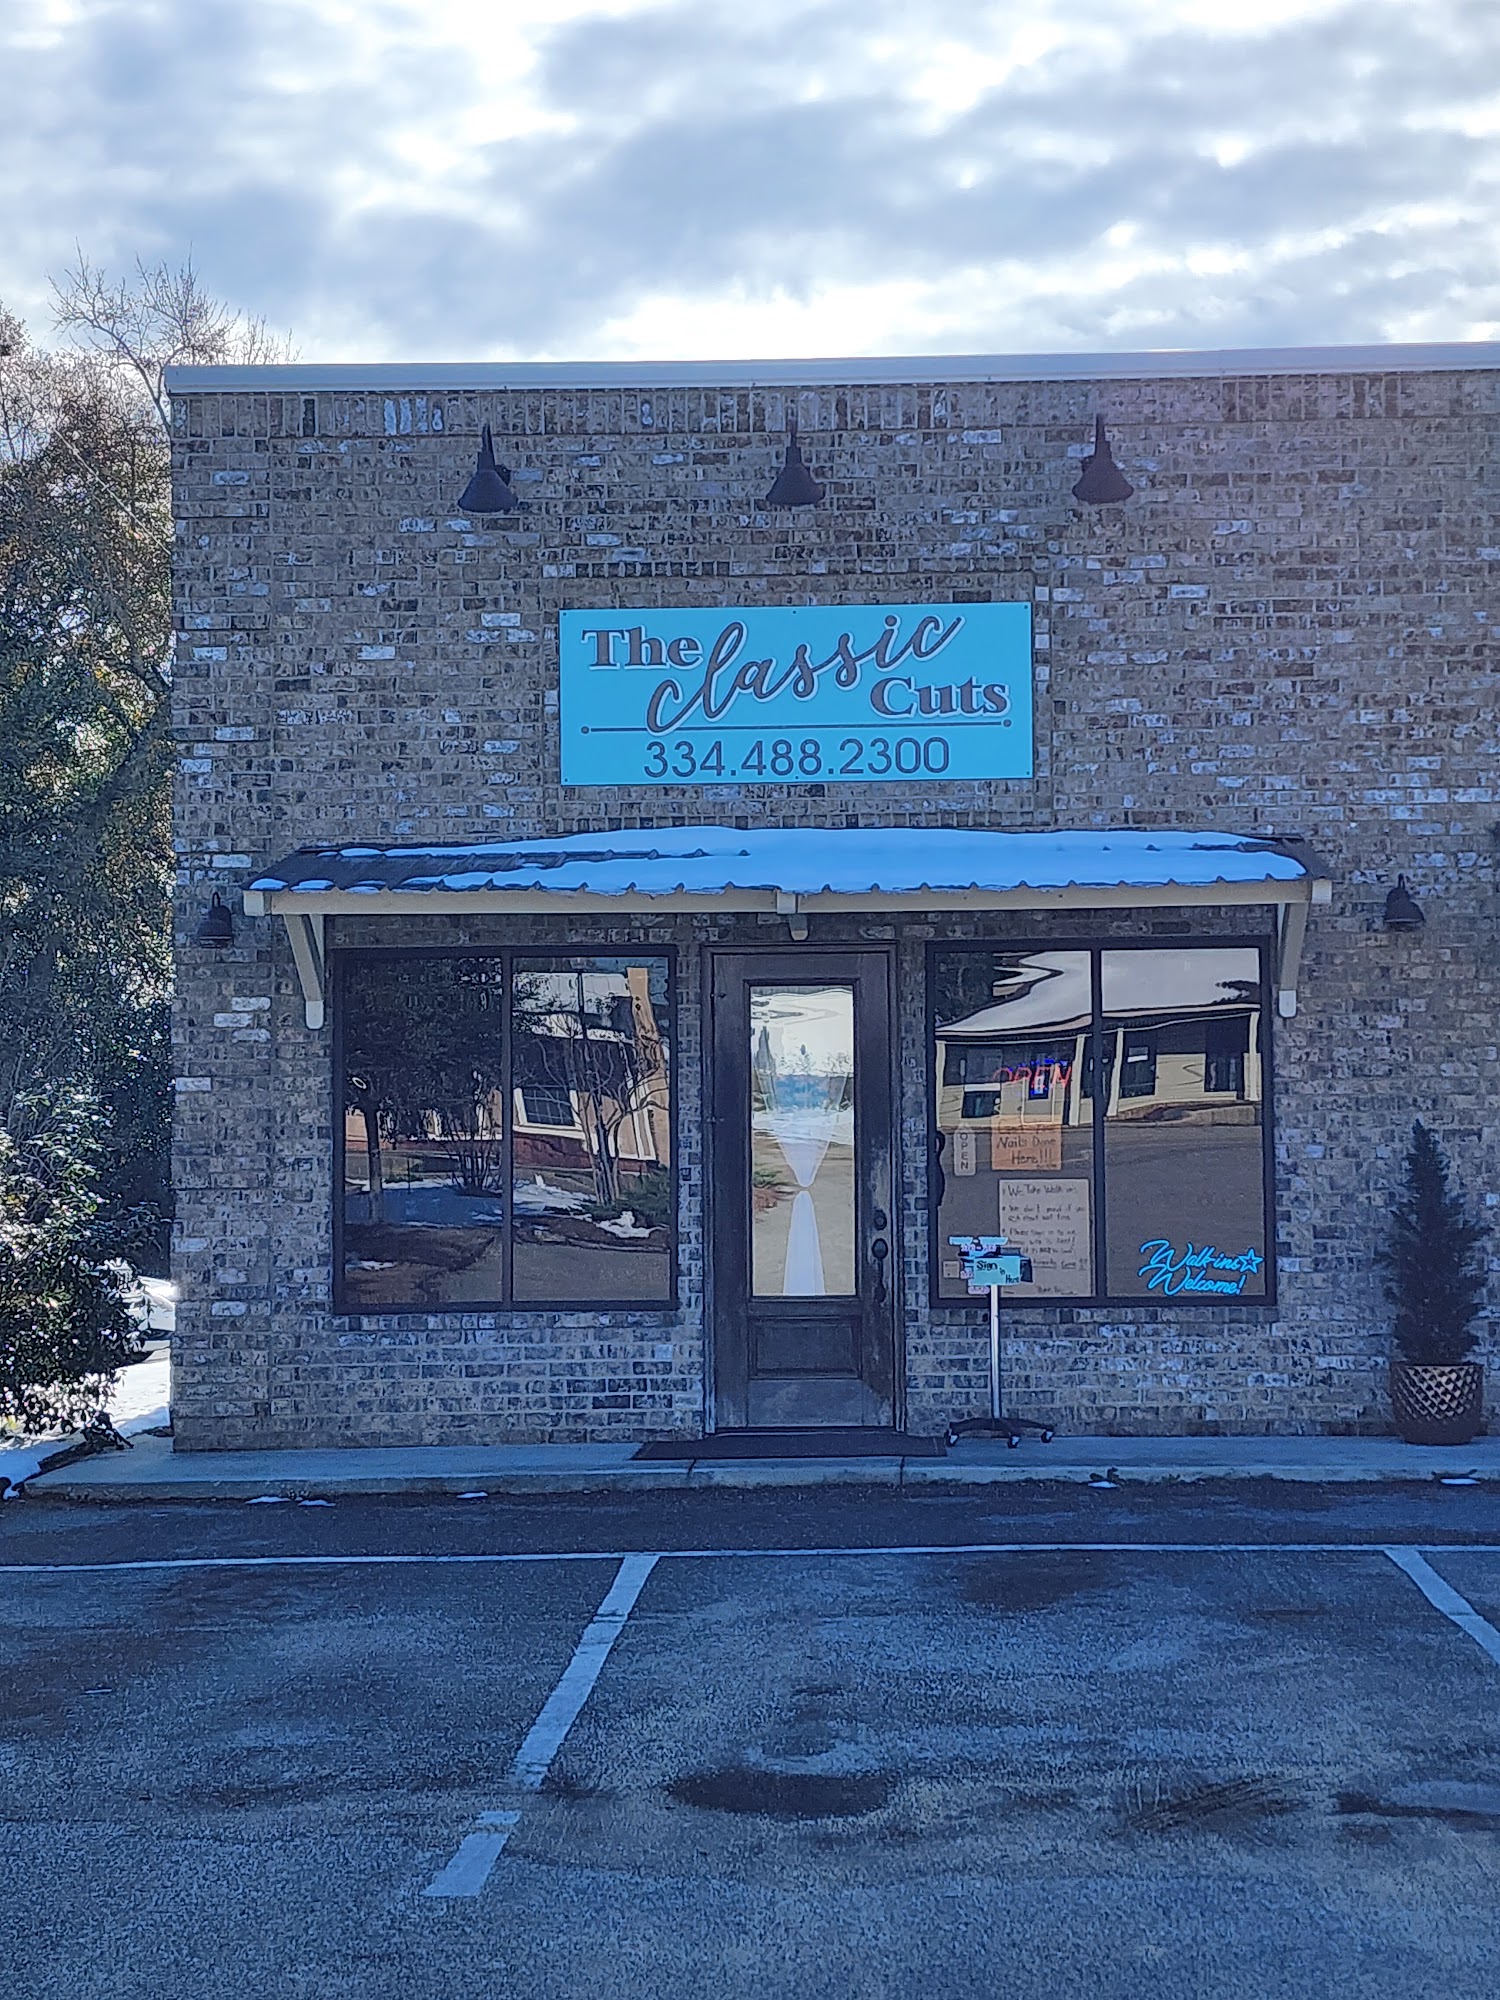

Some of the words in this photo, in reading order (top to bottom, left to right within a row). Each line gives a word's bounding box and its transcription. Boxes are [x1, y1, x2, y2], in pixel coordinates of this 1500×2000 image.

[582, 625, 703, 669] The
[646, 614, 964, 734] Classic
[870, 676, 1010, 719] Cuts
[643, 736, 951, 778] 334.488.2300
[992, 1064, 1073, 1090] OPEN
[959, 1131, 970, 1170] OPEN
[976, 1260, 998, 1271] Sign
[1139, 1239, 1241, 1272] Walk-ins
[1137, 1263, 1246, 1295] Welcome!
